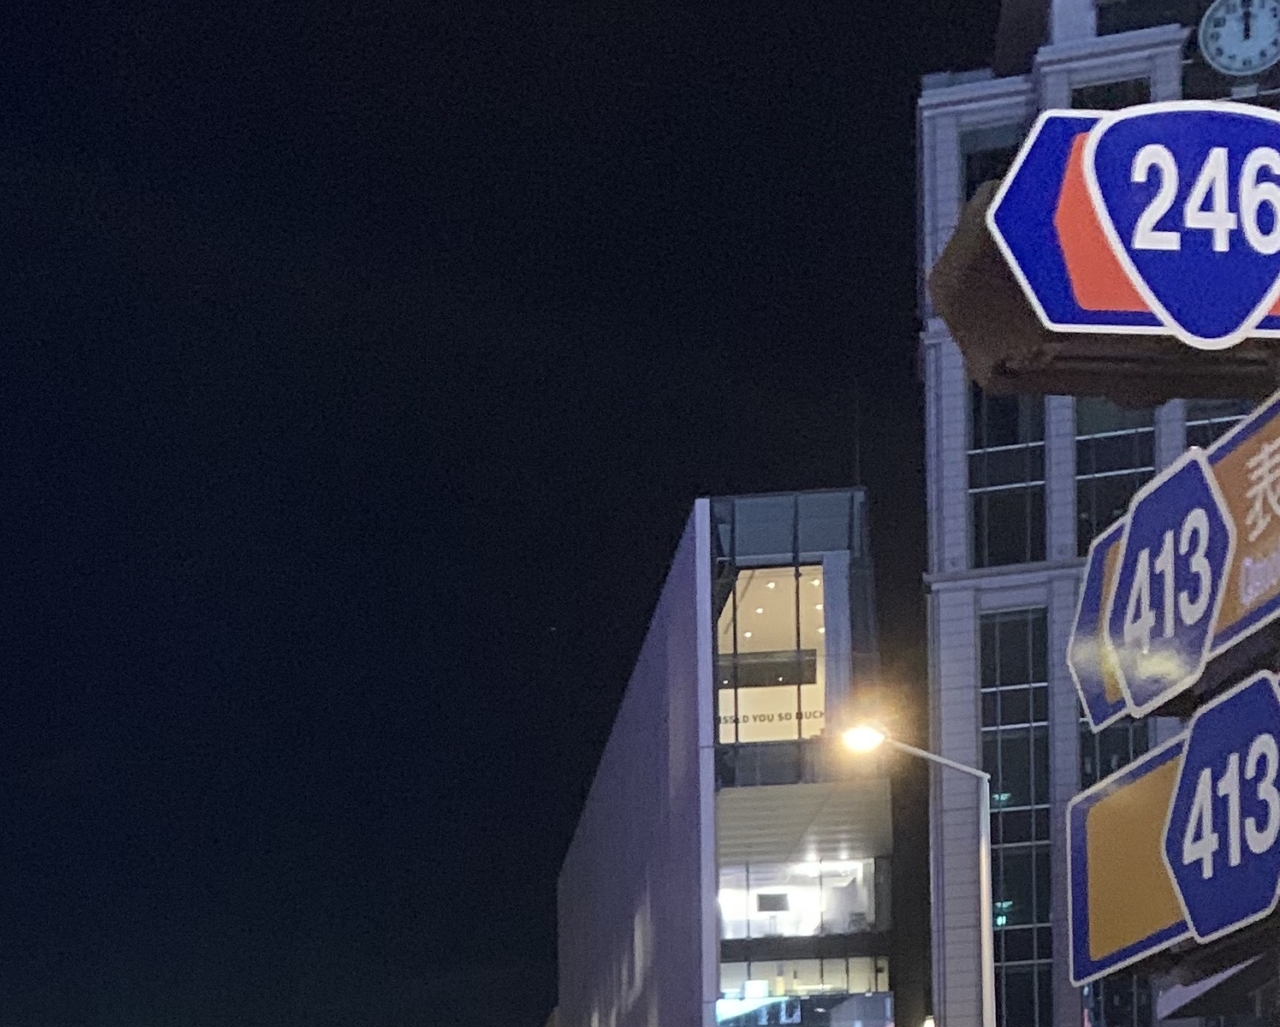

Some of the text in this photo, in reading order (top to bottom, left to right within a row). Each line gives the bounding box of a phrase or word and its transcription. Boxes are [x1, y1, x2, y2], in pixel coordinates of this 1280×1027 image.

[1131, 143, 1280, 255] 246
[1123, 508, 1212, 654] 413
[752, 714, 774, 722] YOU
[1183, 734, 1280, 879] 413
